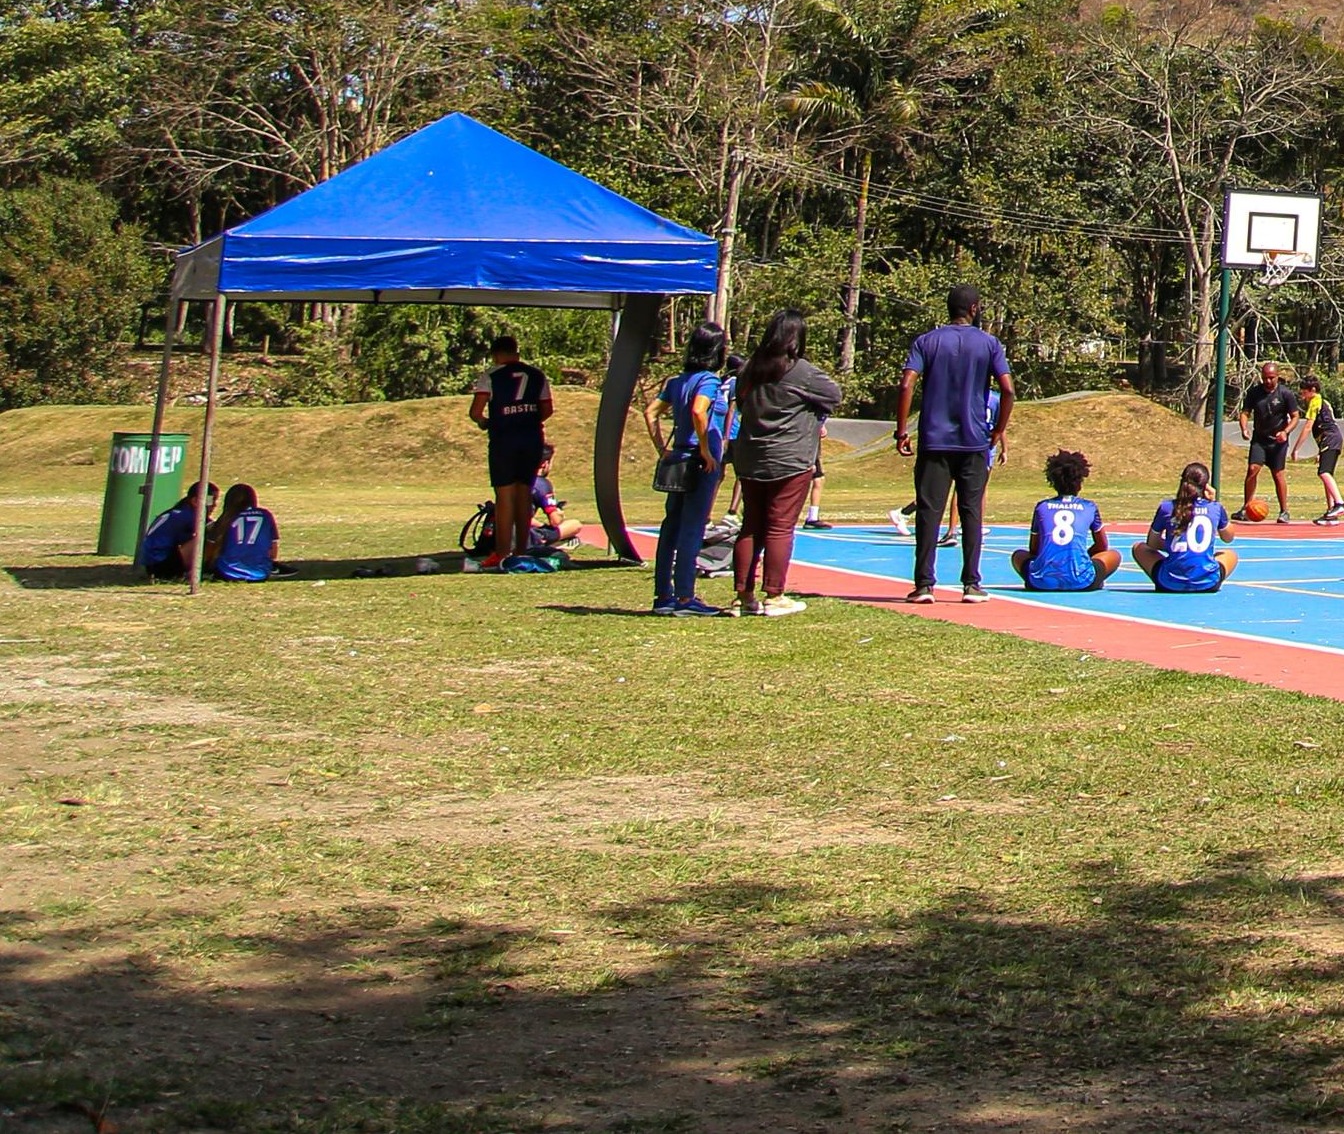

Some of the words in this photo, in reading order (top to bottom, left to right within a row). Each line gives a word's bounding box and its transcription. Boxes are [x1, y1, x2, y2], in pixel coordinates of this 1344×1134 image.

[512, 372, 528, 401] 7
[112, 446, 182, 473] COMEP
[1047, 502, 1084, 511] THALITA
[231, 516, 264, 545] 17
[1052, 510, 1075, 546] 8
